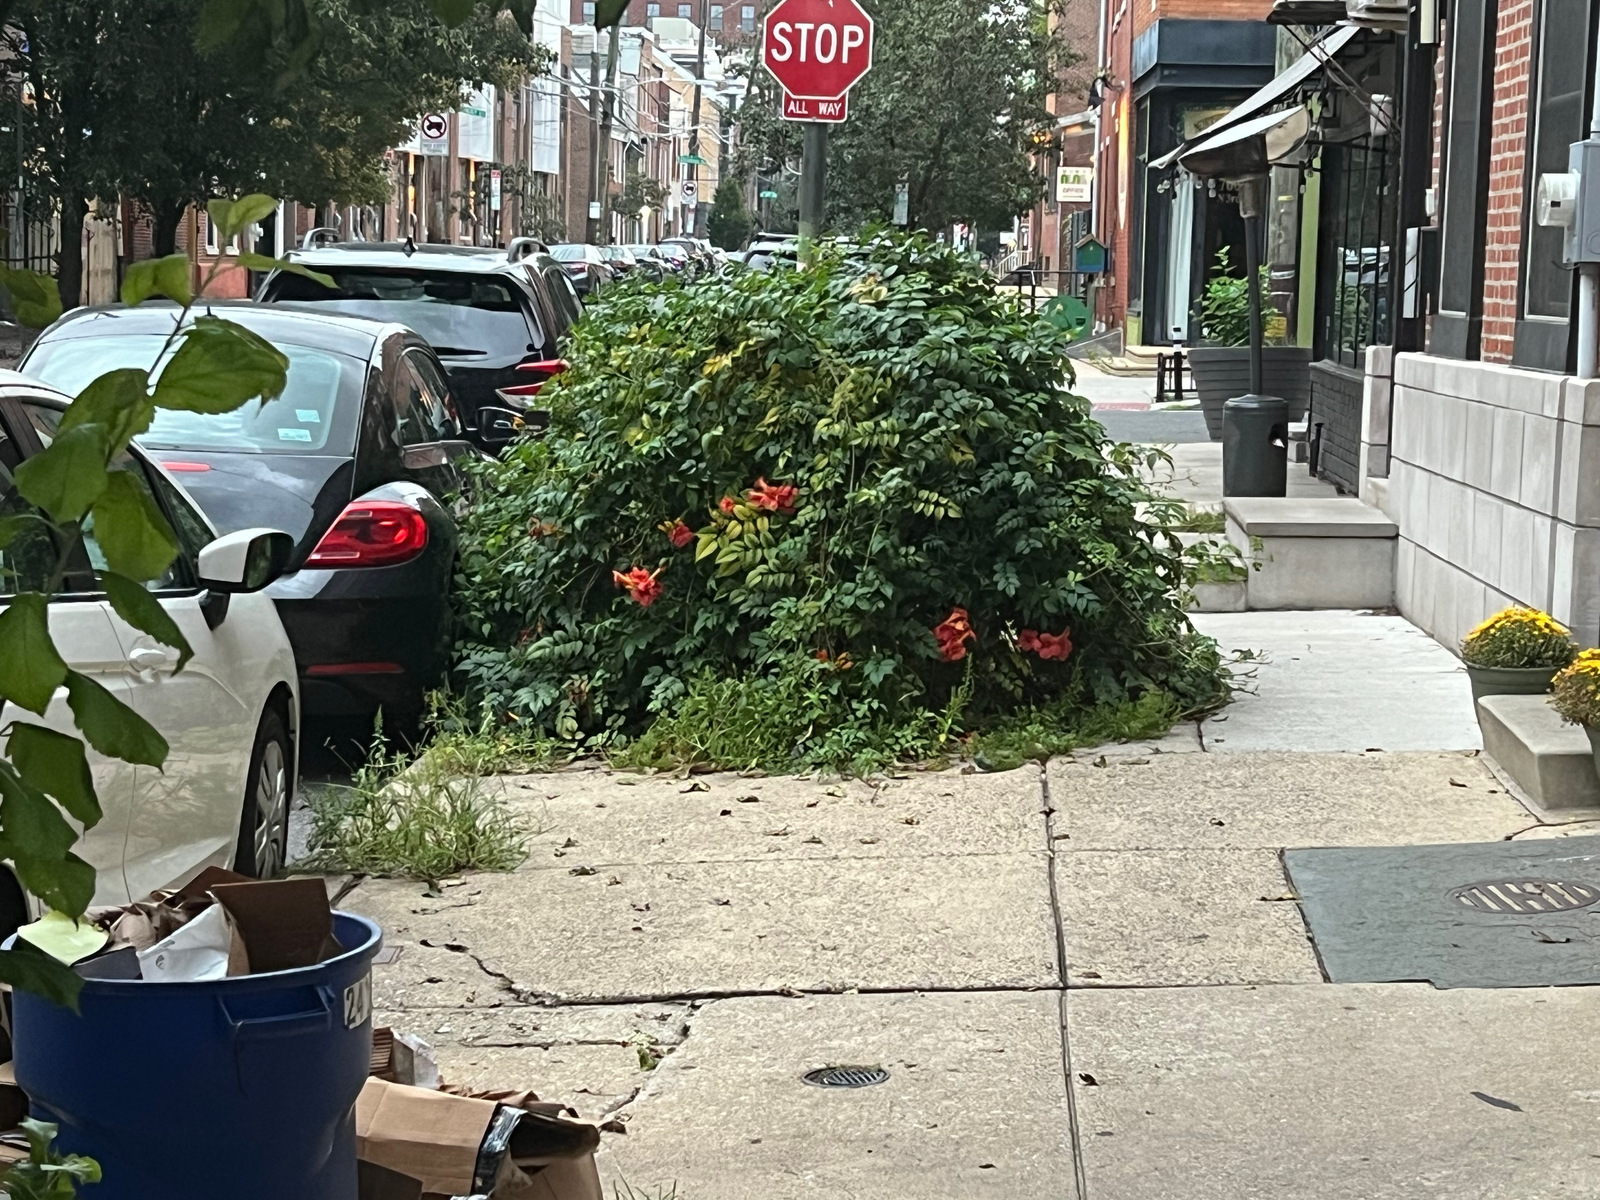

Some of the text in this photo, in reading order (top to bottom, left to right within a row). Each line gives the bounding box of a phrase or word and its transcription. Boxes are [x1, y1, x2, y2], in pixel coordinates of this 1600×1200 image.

[771, 21, 864, 64] STOP
[787, 100, 842, 116] ALL WAY
